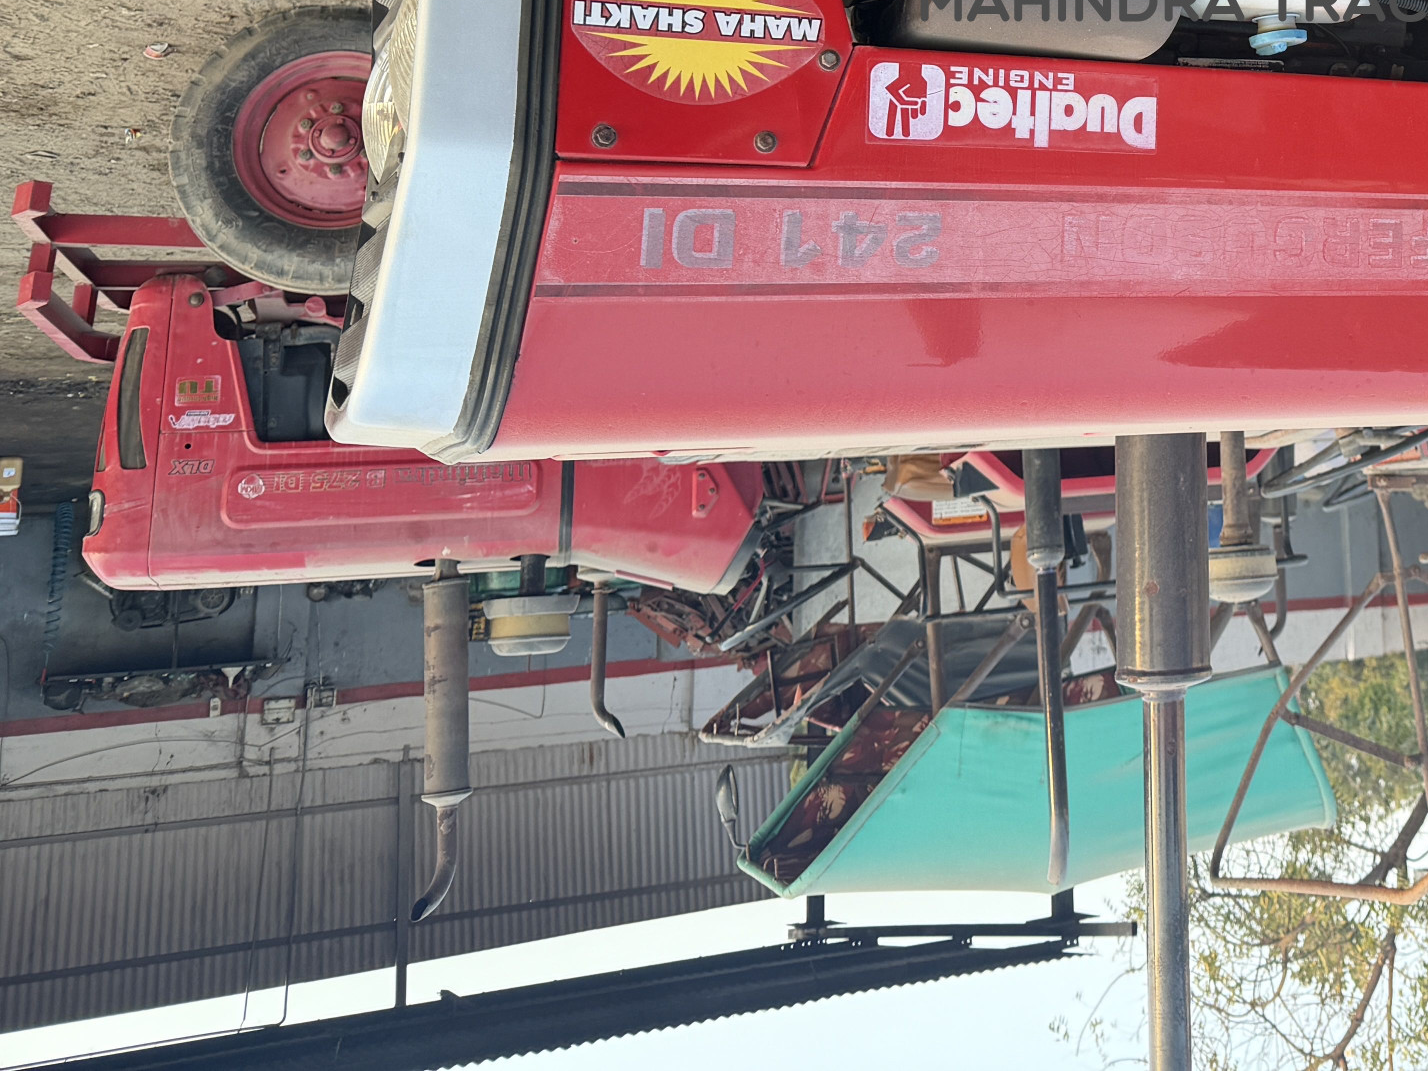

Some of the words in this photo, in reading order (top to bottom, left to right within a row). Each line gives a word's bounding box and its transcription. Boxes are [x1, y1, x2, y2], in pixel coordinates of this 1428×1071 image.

[572, 0, 706, 34] SHAKTI
[713, 9, 822, 43] MAHA
[949, 66, 1075, 90] ENGINE
[948, 86, 1158, 150] Dualtec
[640, 207, 736, 269] DI
[779, 209, 943, 268] 241
[167, 459, 215, 476] DLX
[309, 470, 361, 491] 275
